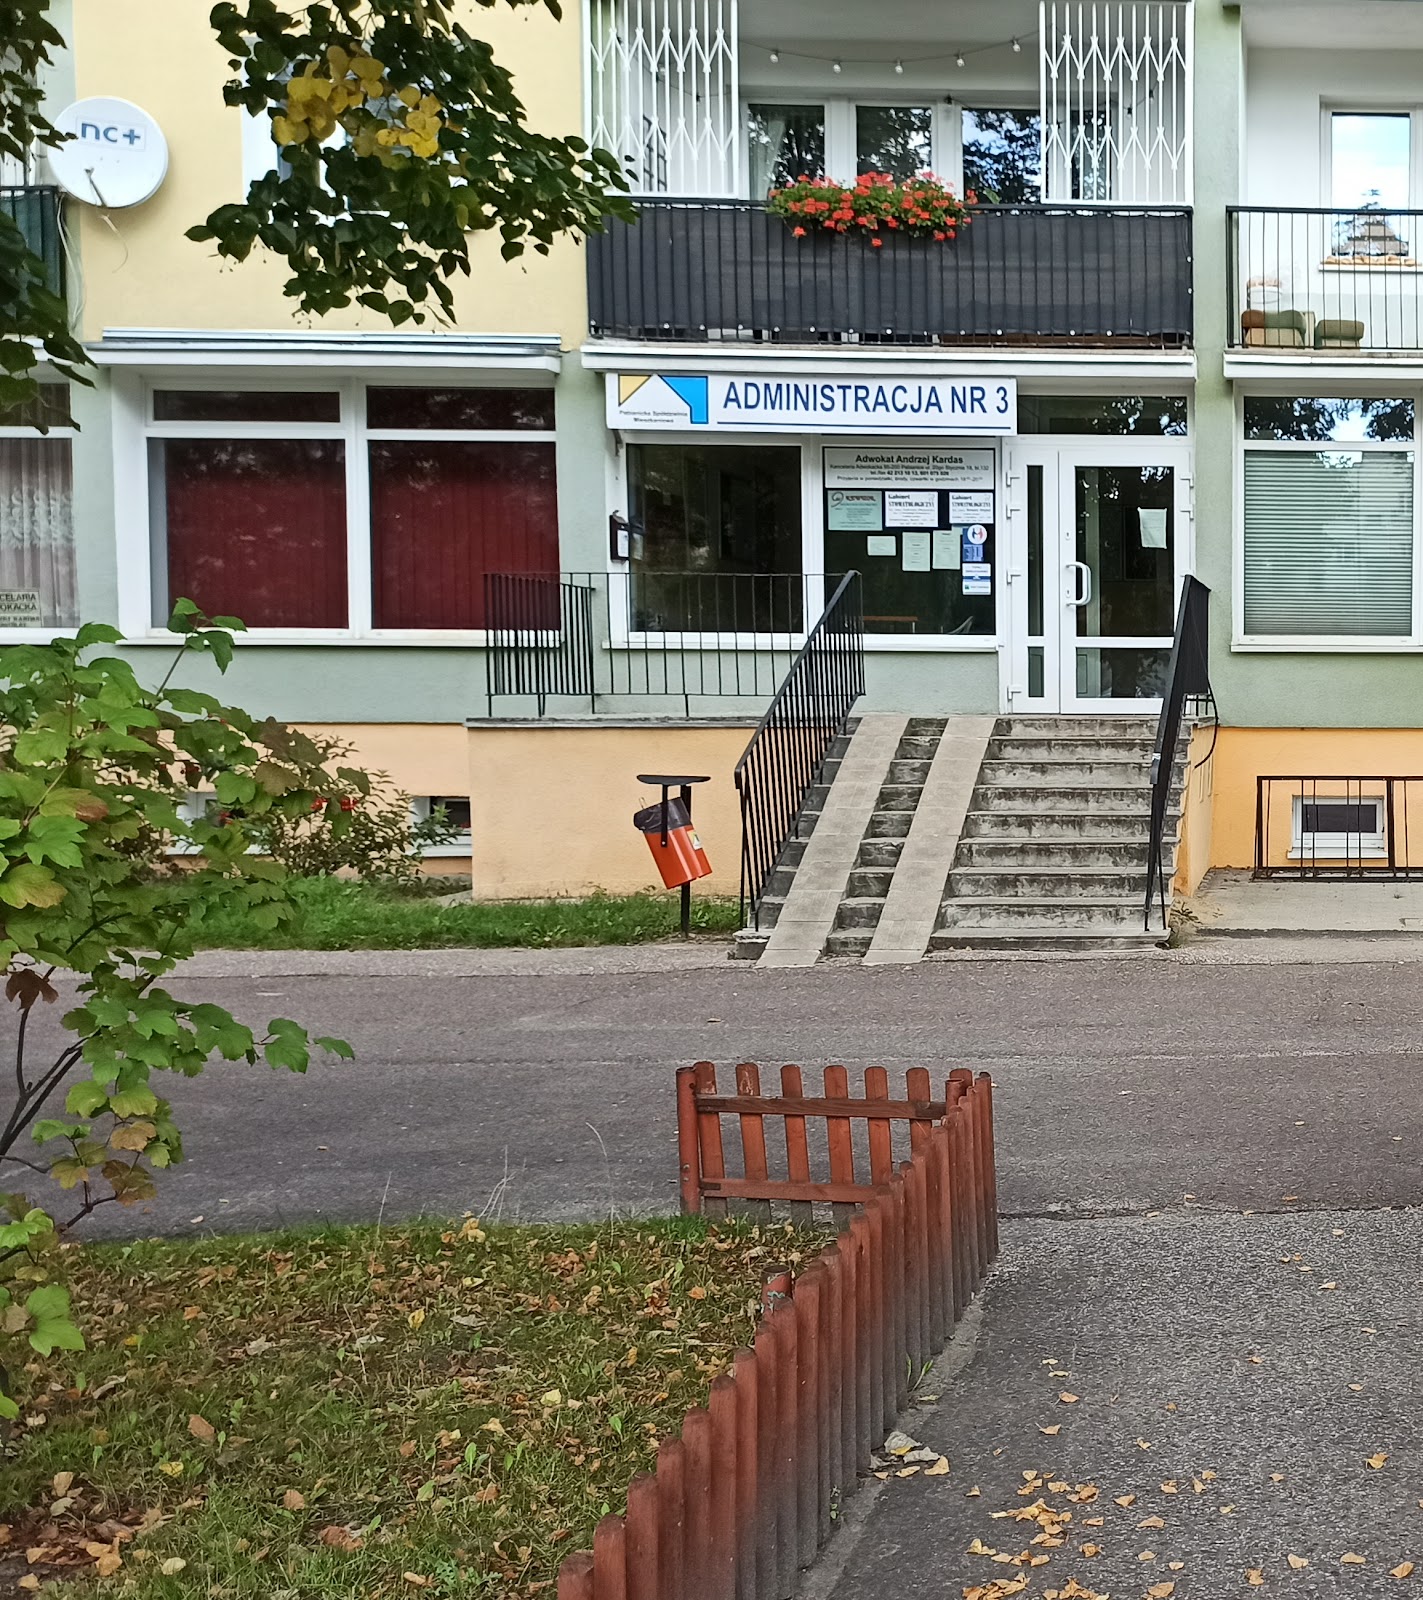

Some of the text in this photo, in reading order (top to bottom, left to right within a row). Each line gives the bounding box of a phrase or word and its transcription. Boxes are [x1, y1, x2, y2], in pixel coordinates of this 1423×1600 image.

[81, 122, 141, 145] nc+
[723, 381, 1009, 414] ADMINISTRACJA NR 3
[855, 455, 964, 465] Adwokat Andrzej Kardas
